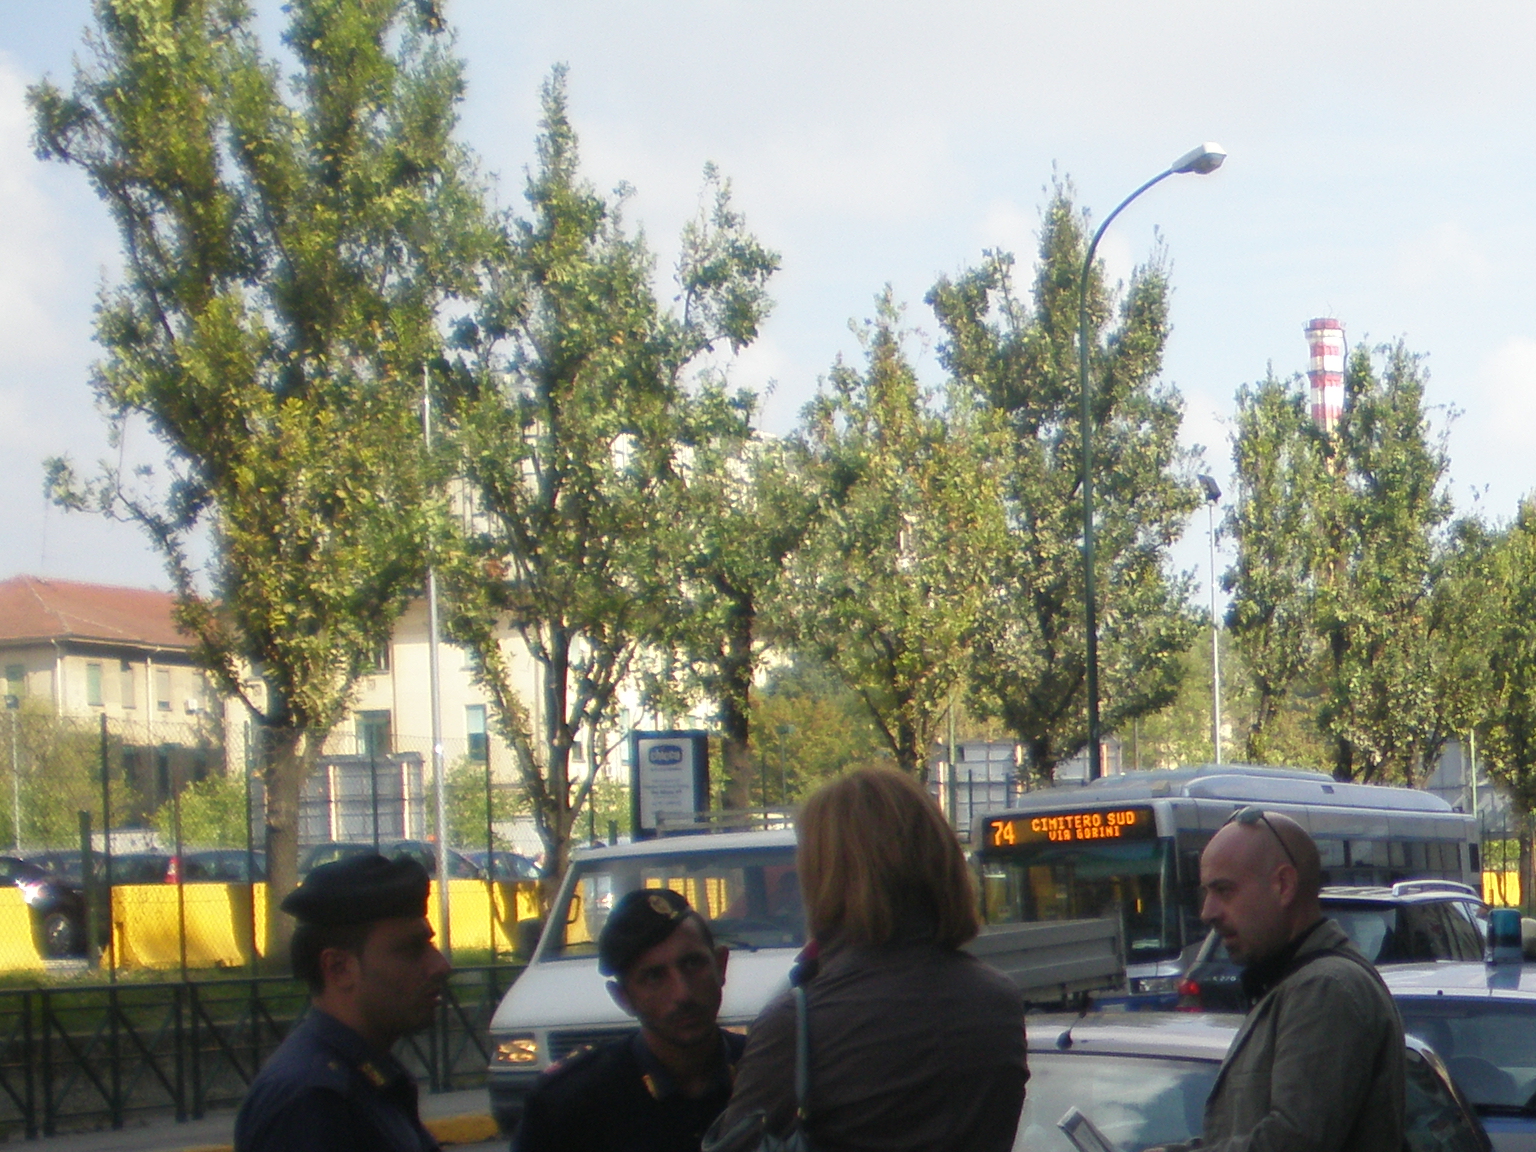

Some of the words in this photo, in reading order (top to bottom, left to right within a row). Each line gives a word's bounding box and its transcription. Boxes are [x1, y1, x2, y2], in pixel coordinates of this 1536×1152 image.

[1032, 814, 1101, 832] CIMITERO
[1108, 810, 1135, 826] SUD
[992, 821, 1015, 846] 74
[1049, 829, 1070, 841] VIA
[1077, 826, 1120, 840] GORINI
